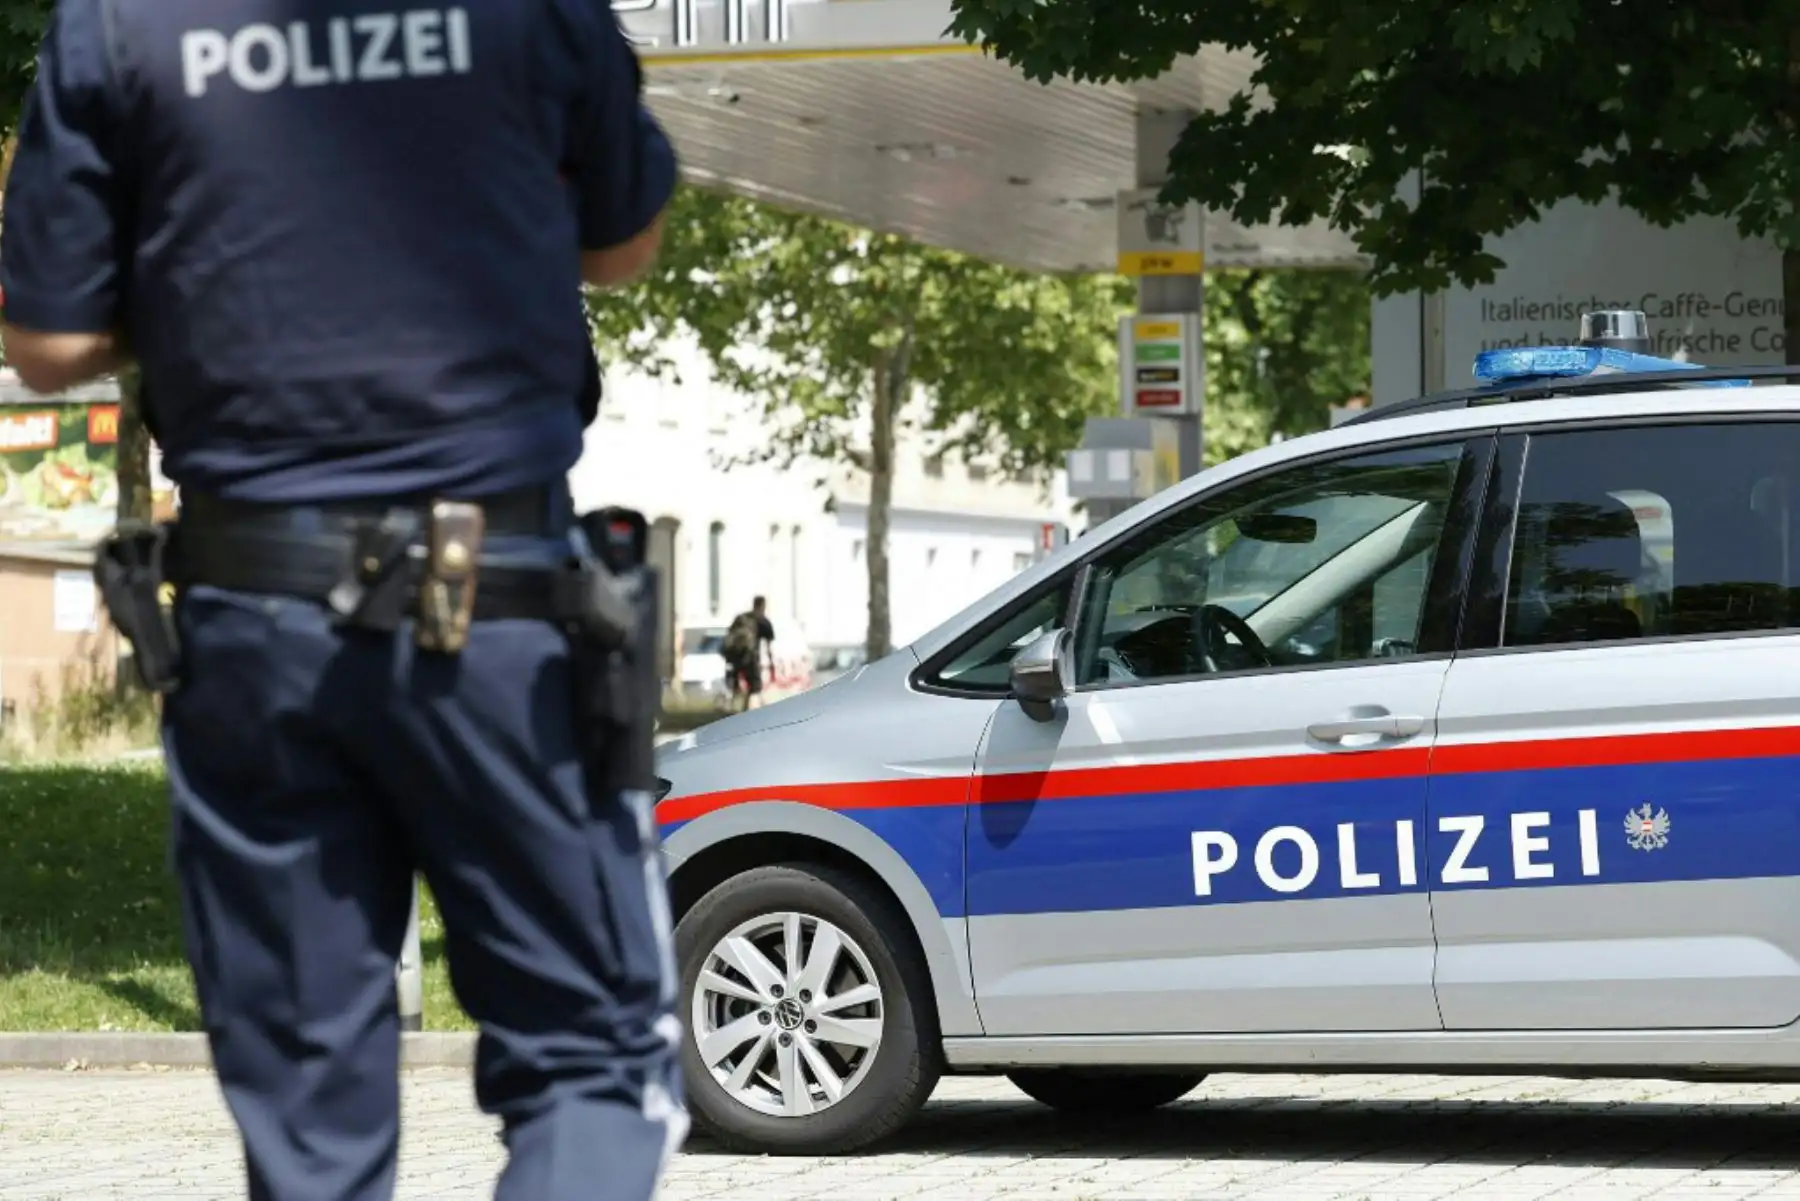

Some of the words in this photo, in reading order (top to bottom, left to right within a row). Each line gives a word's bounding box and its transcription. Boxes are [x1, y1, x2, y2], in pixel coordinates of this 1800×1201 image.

[180, 6, 472, 98] POLIZEI
[1481, 294, 1631, 322] Italienischer
[1191, 809, 1601, 896] POLIZEI
